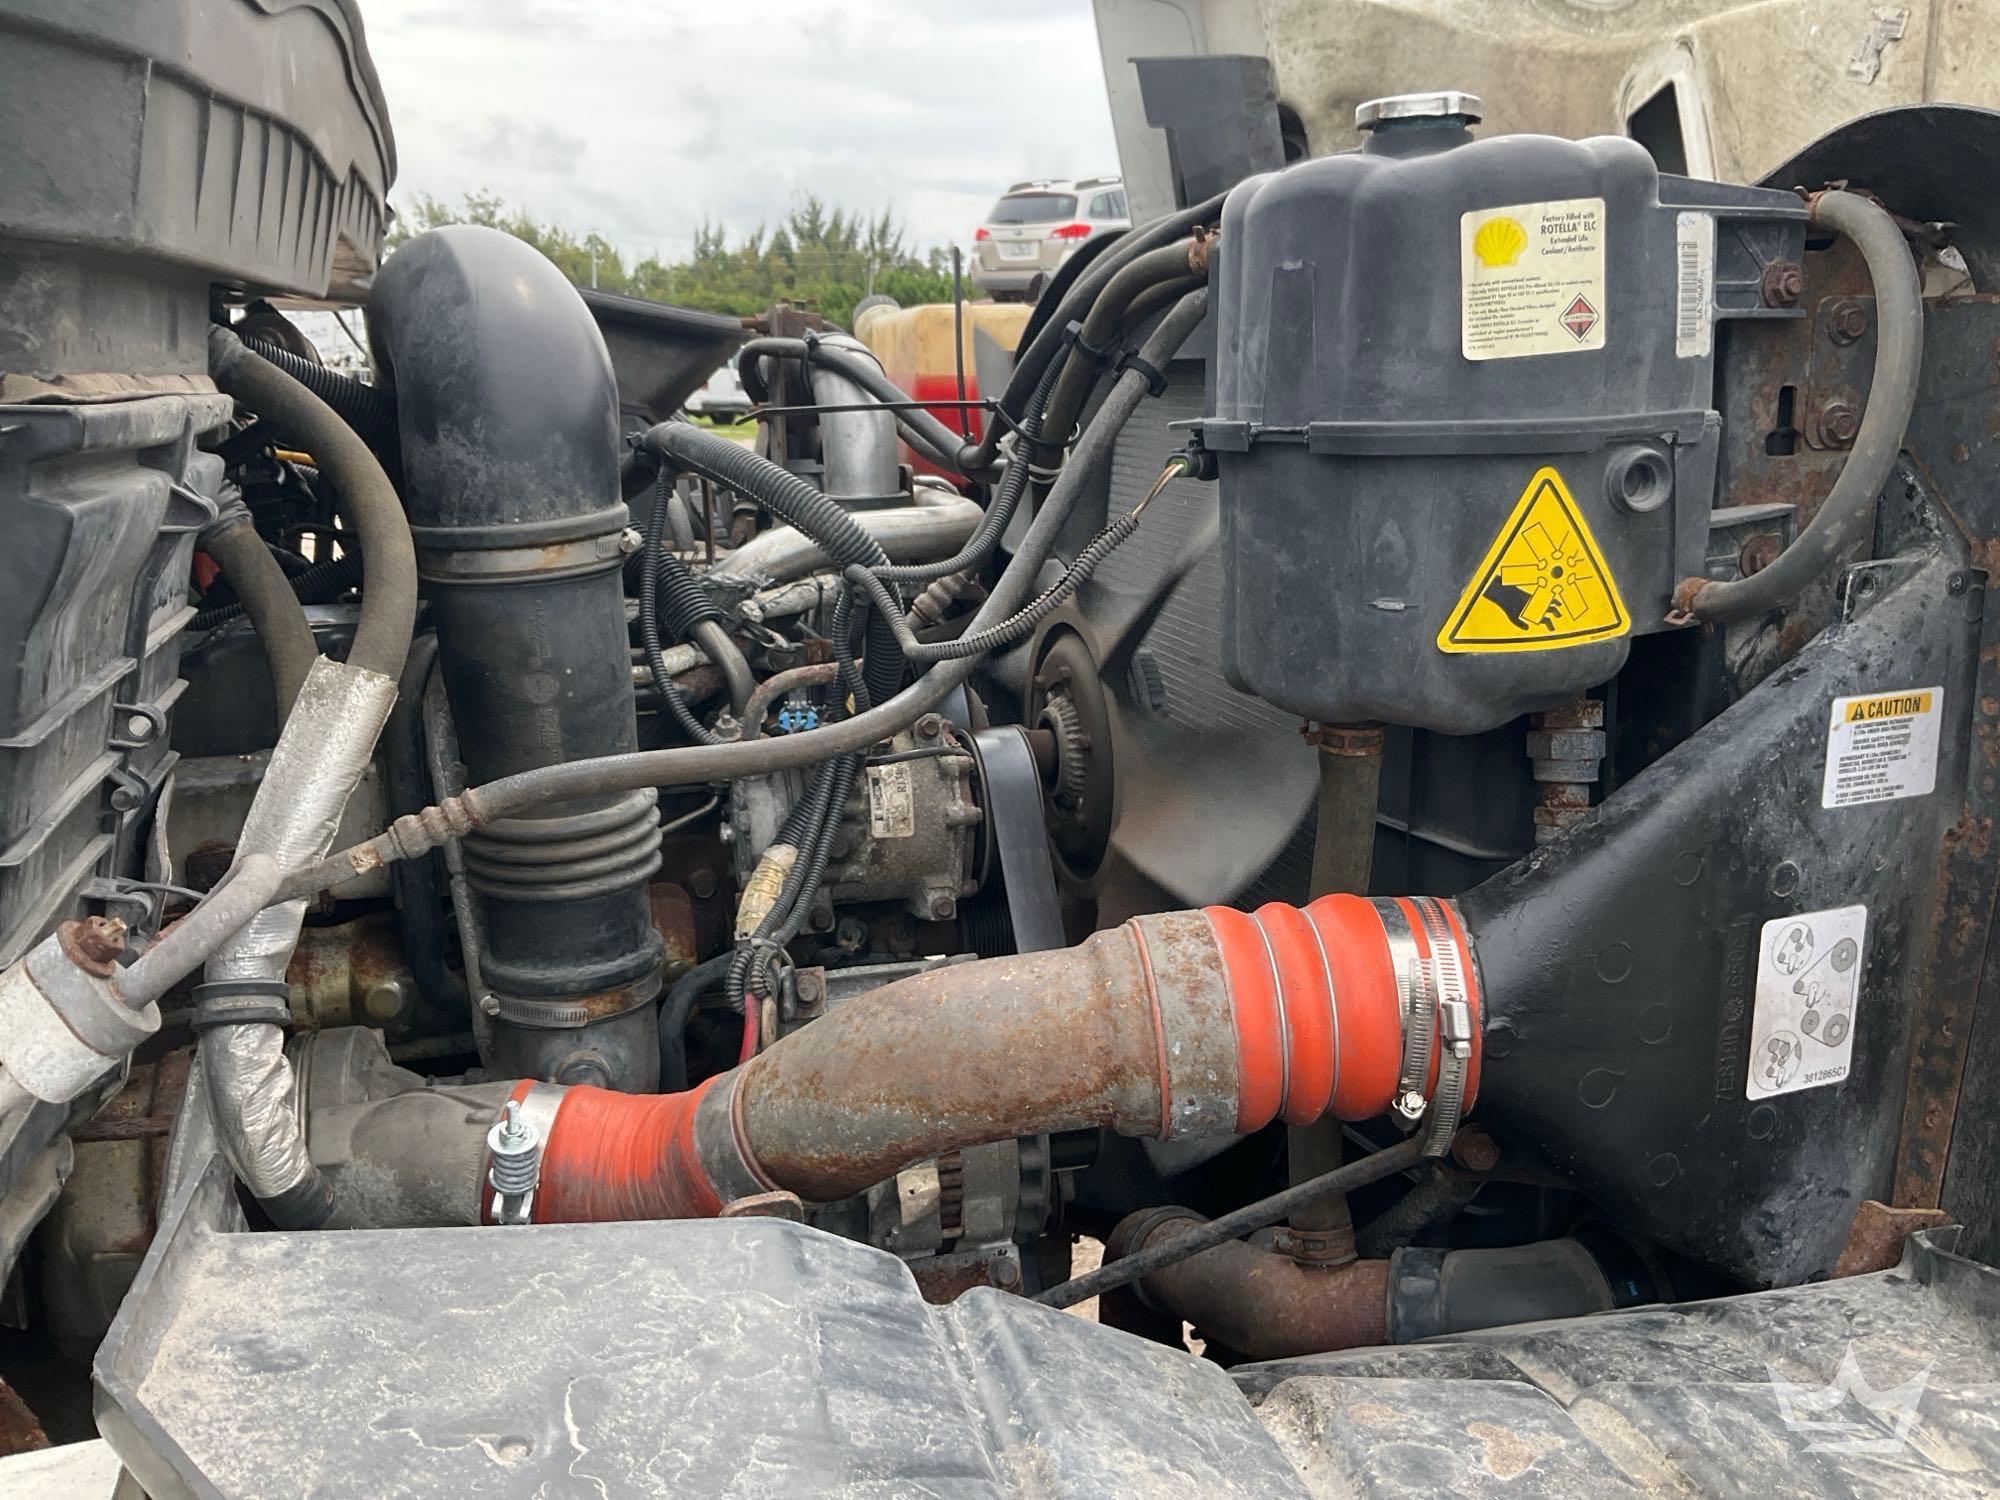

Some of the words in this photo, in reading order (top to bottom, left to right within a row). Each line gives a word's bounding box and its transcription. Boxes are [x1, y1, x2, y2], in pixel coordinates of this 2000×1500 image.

[1584, 221, 1596, 232] ELC
[1550, 235, 1576, 244] Extended
[1867, 697, 1921, 718] CAUTION
[1803, 1066, 1847, 1084] 3812865C1
